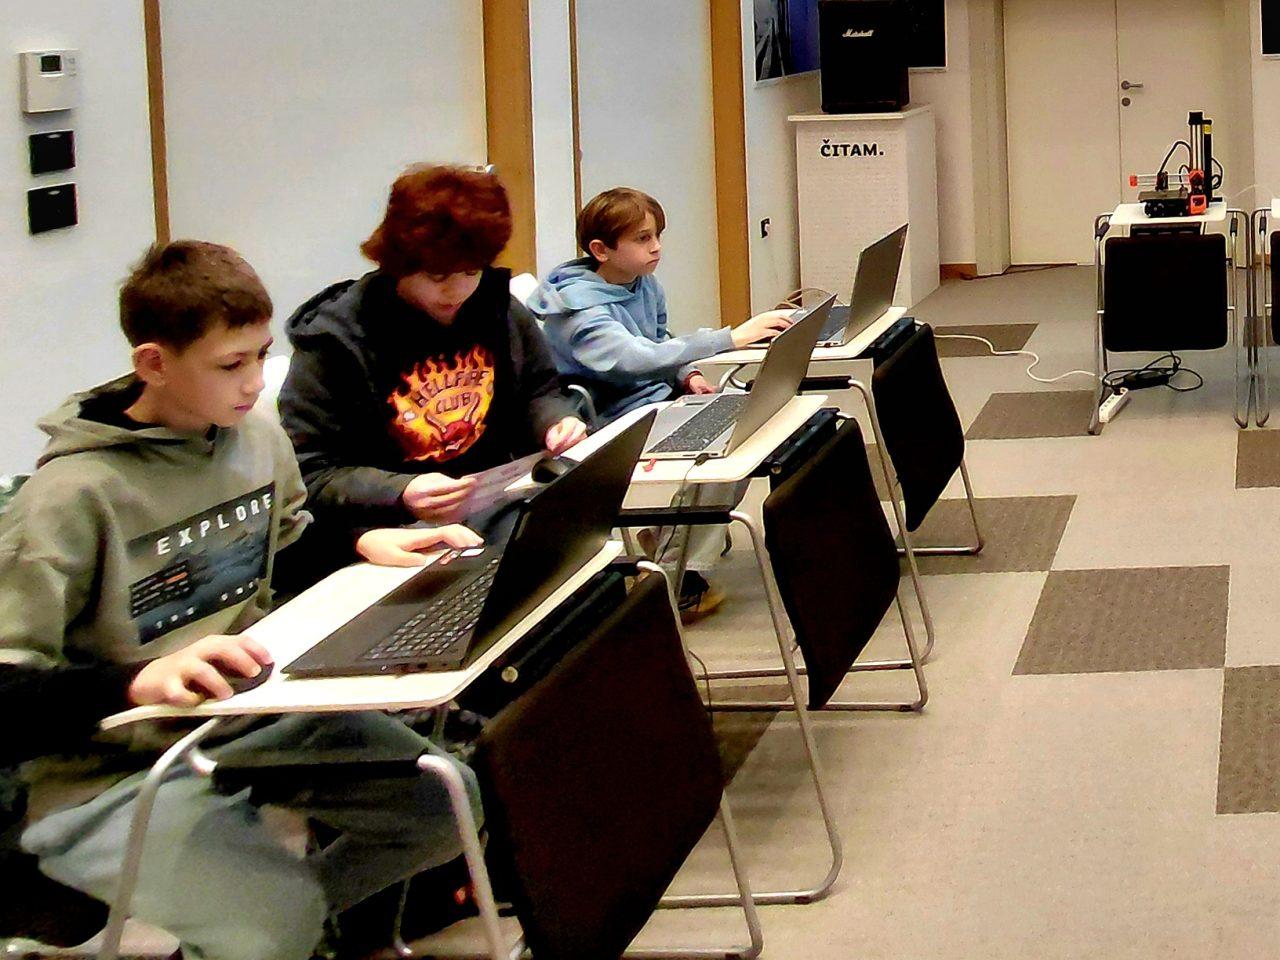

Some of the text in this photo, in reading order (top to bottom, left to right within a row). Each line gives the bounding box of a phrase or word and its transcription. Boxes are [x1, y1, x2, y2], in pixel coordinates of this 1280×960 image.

[820, 139, 884, 158] ČITAM.
[411, 369, 490, 408] HELLFIRE
[436, 391, 471, 414] CLUB
[156, 493, 273, 556] EXPLORE
